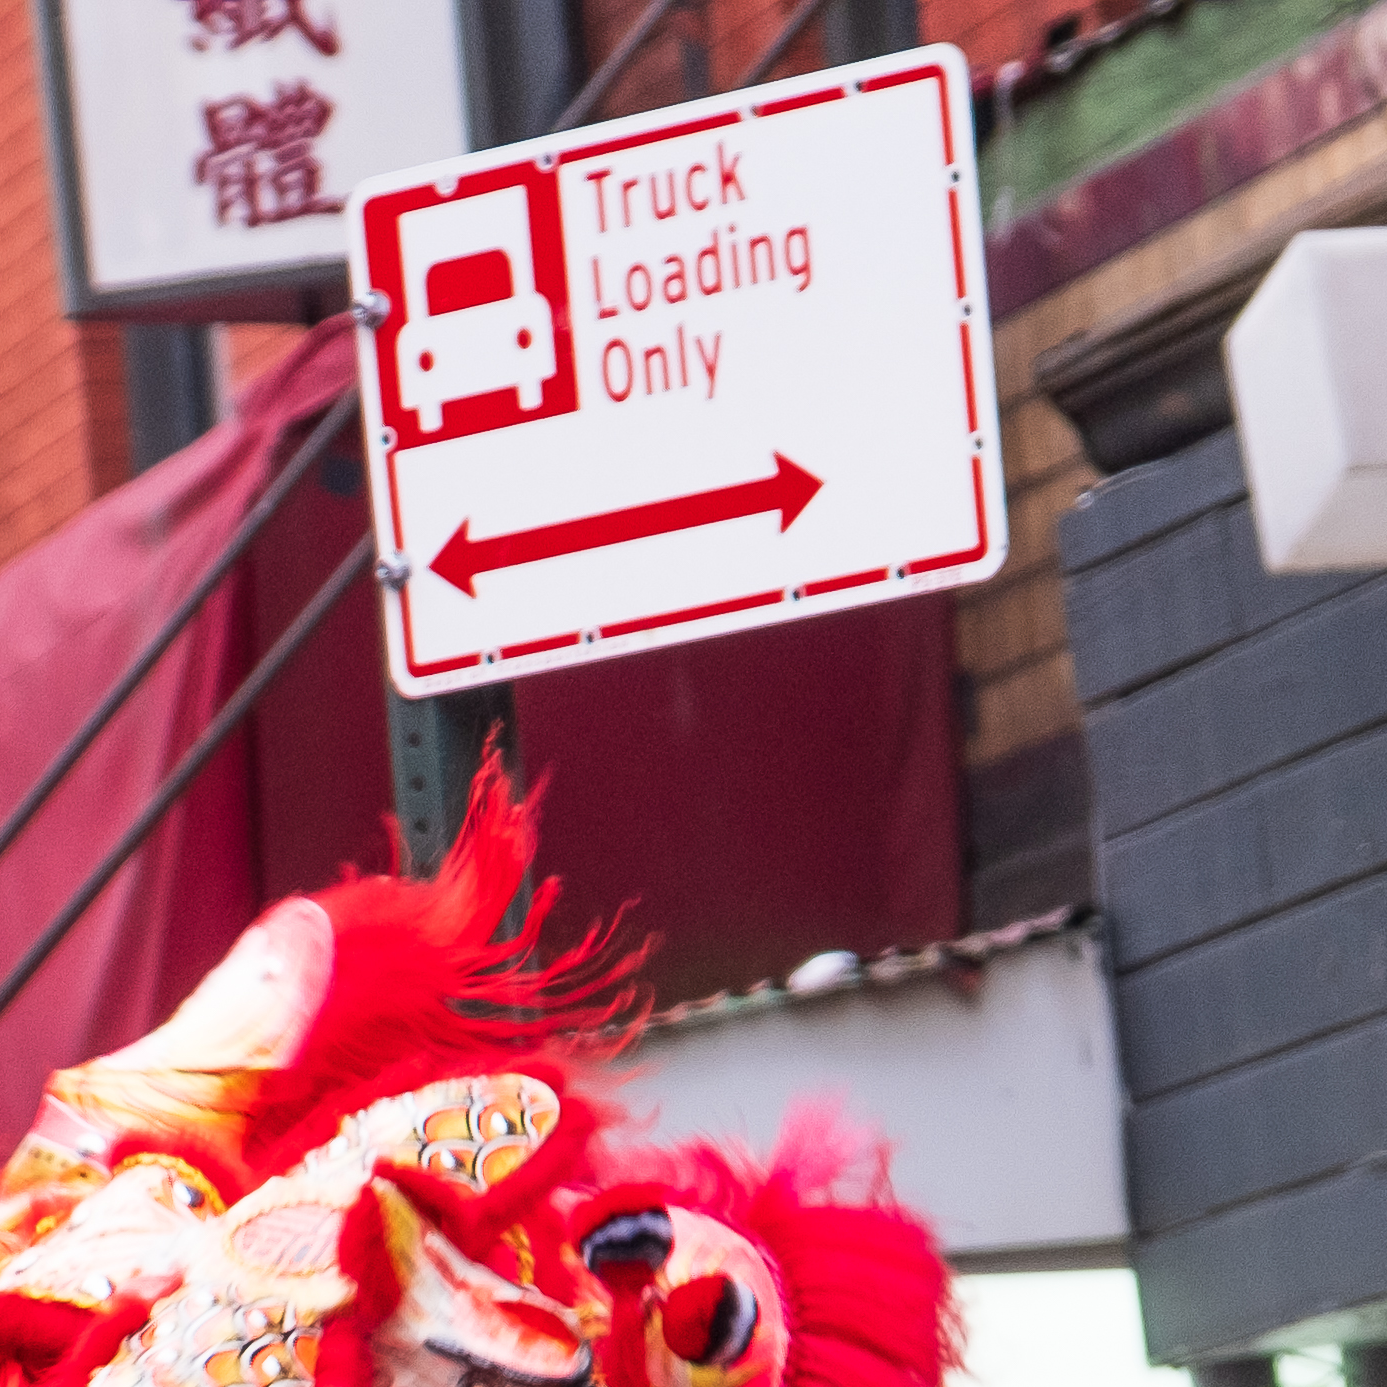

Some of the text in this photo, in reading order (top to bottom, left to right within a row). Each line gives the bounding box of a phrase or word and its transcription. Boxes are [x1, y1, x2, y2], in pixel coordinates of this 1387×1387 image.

[585, 139, 746, 233] Truck
[591, 223, 812, 320] Loading
[602, 321, 722, 403] Only
